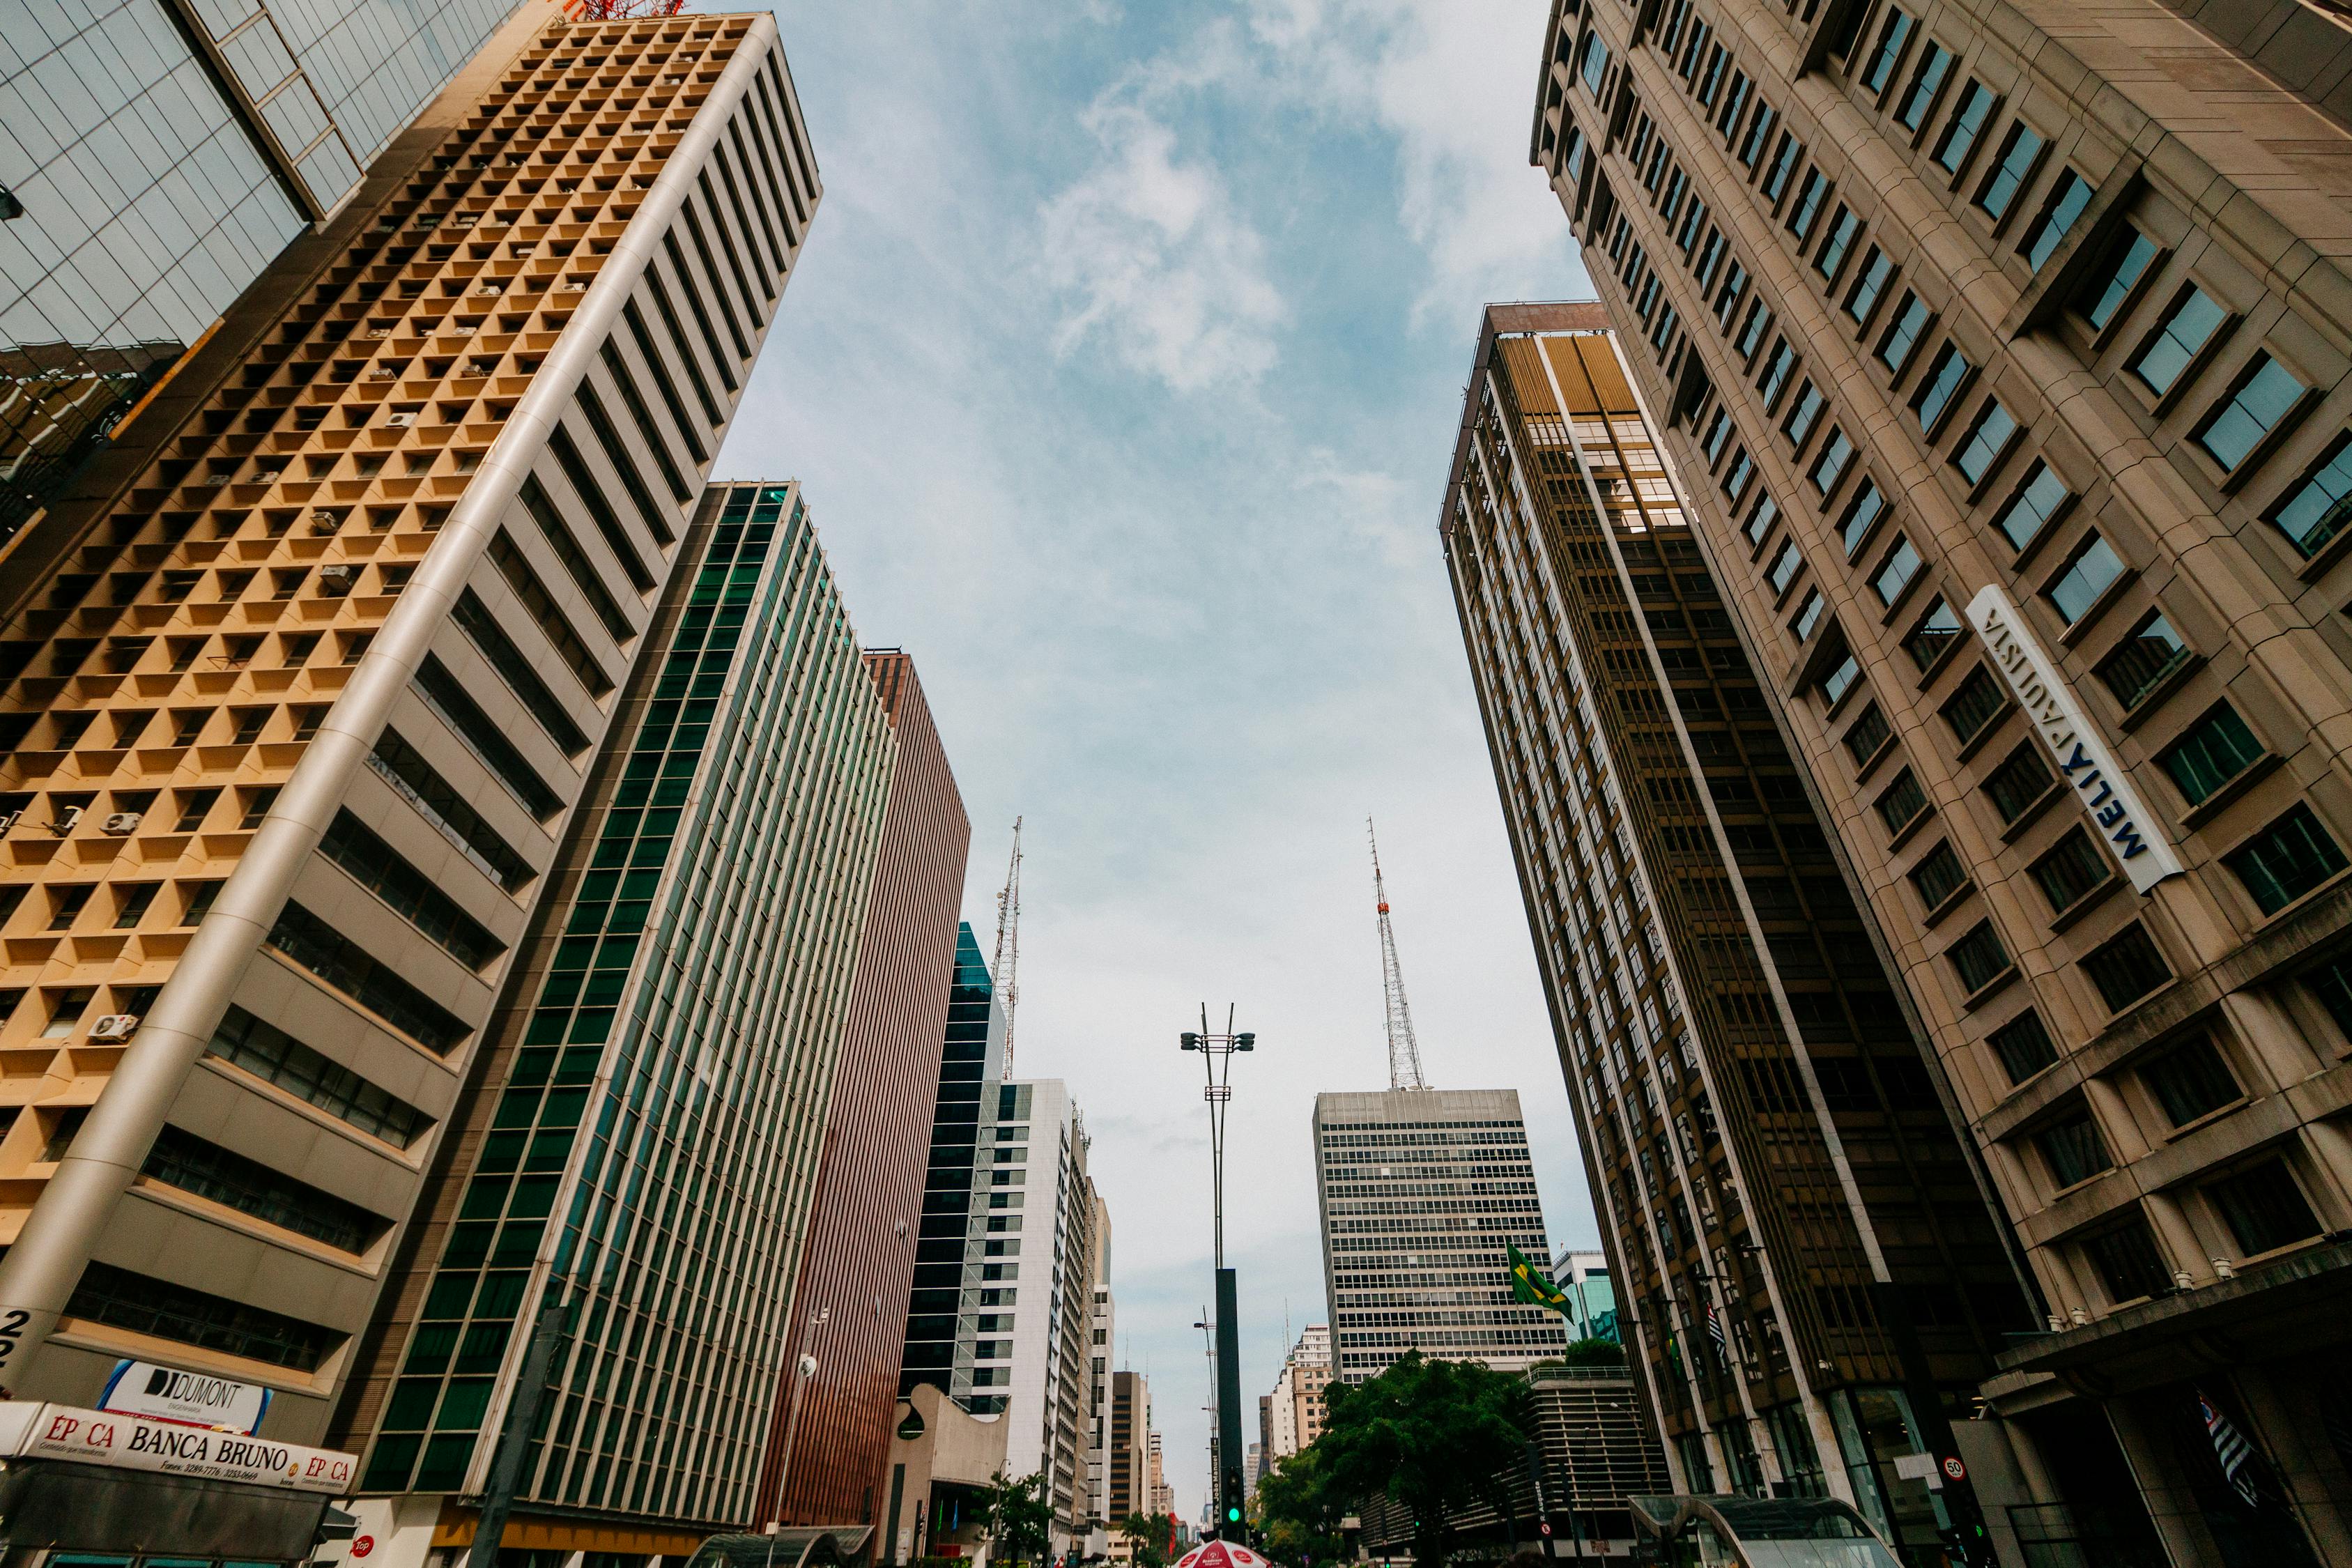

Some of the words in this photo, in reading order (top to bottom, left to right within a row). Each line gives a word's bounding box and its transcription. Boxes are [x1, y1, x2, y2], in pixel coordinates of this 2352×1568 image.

[1983, 608, 2075, 749] PAULISTA
[2061, 742, 2147, 859] MELIÁ
[172, 1374, 242, 1409] DUMONT
[127, 1426, 208, 1461] BANCA
[215, 1440, 288, 1471] BRUNO
[160, 1461, 183, 1471] Fones:
[184, 1463, 221, 1476] 3289-7776
[1946, 1462, 1961, 1473] 50
[1535, 1481, 1544, 1513] Augusta
